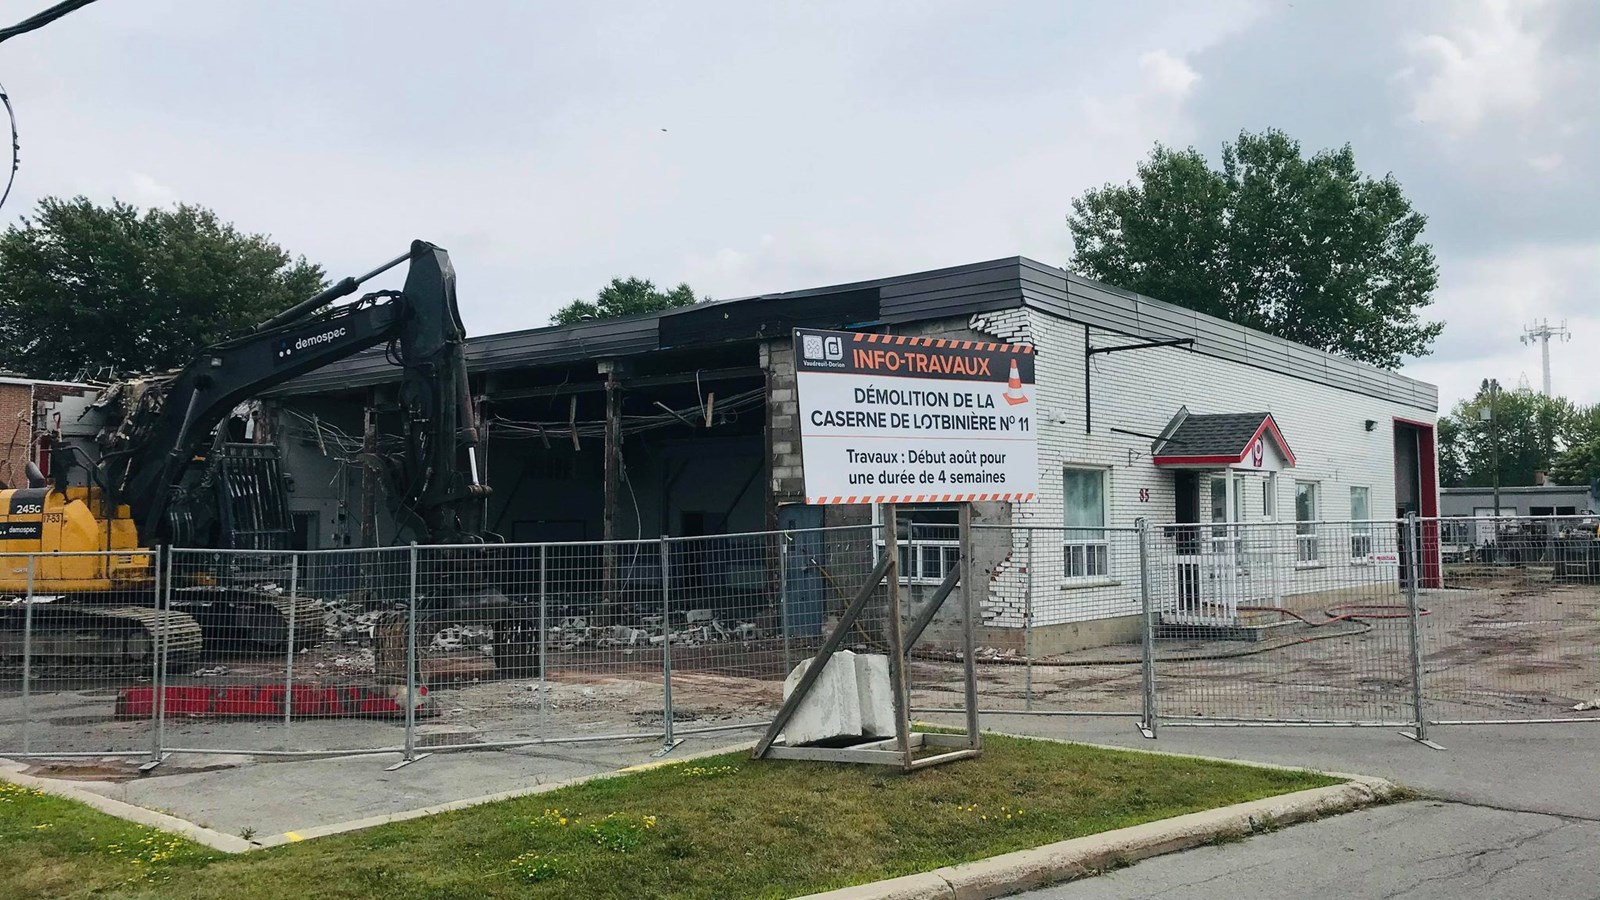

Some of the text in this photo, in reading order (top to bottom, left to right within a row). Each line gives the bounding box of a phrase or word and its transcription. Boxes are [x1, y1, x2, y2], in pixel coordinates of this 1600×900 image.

[295, 327, 346, 350] demospec
[803, 360, 846, 368] Vaudreuil-Dorion
[853, 348, 991, 376] INFO-TRAVAUX
[854, 384, 995, 409] DÉMOLITION DE LA
[811, 410, 887, 428] CASERNE
[891, 412, 910, 429] DE
[914, 411, 996, 431] LOTBINIÈRE
[1018, 417, 1029, 432] 11
[846, 449, 898, 464] Travaux
[908, 449, 946, 464] Début
[949, 450, 977, 464] août
[980, 453, 1006, 467] pour
[849, 470, 1006, 485] une durée de 4 semaines
[16, 504, 41, 514] 245G
[9, 526, 36, 534] demospec
